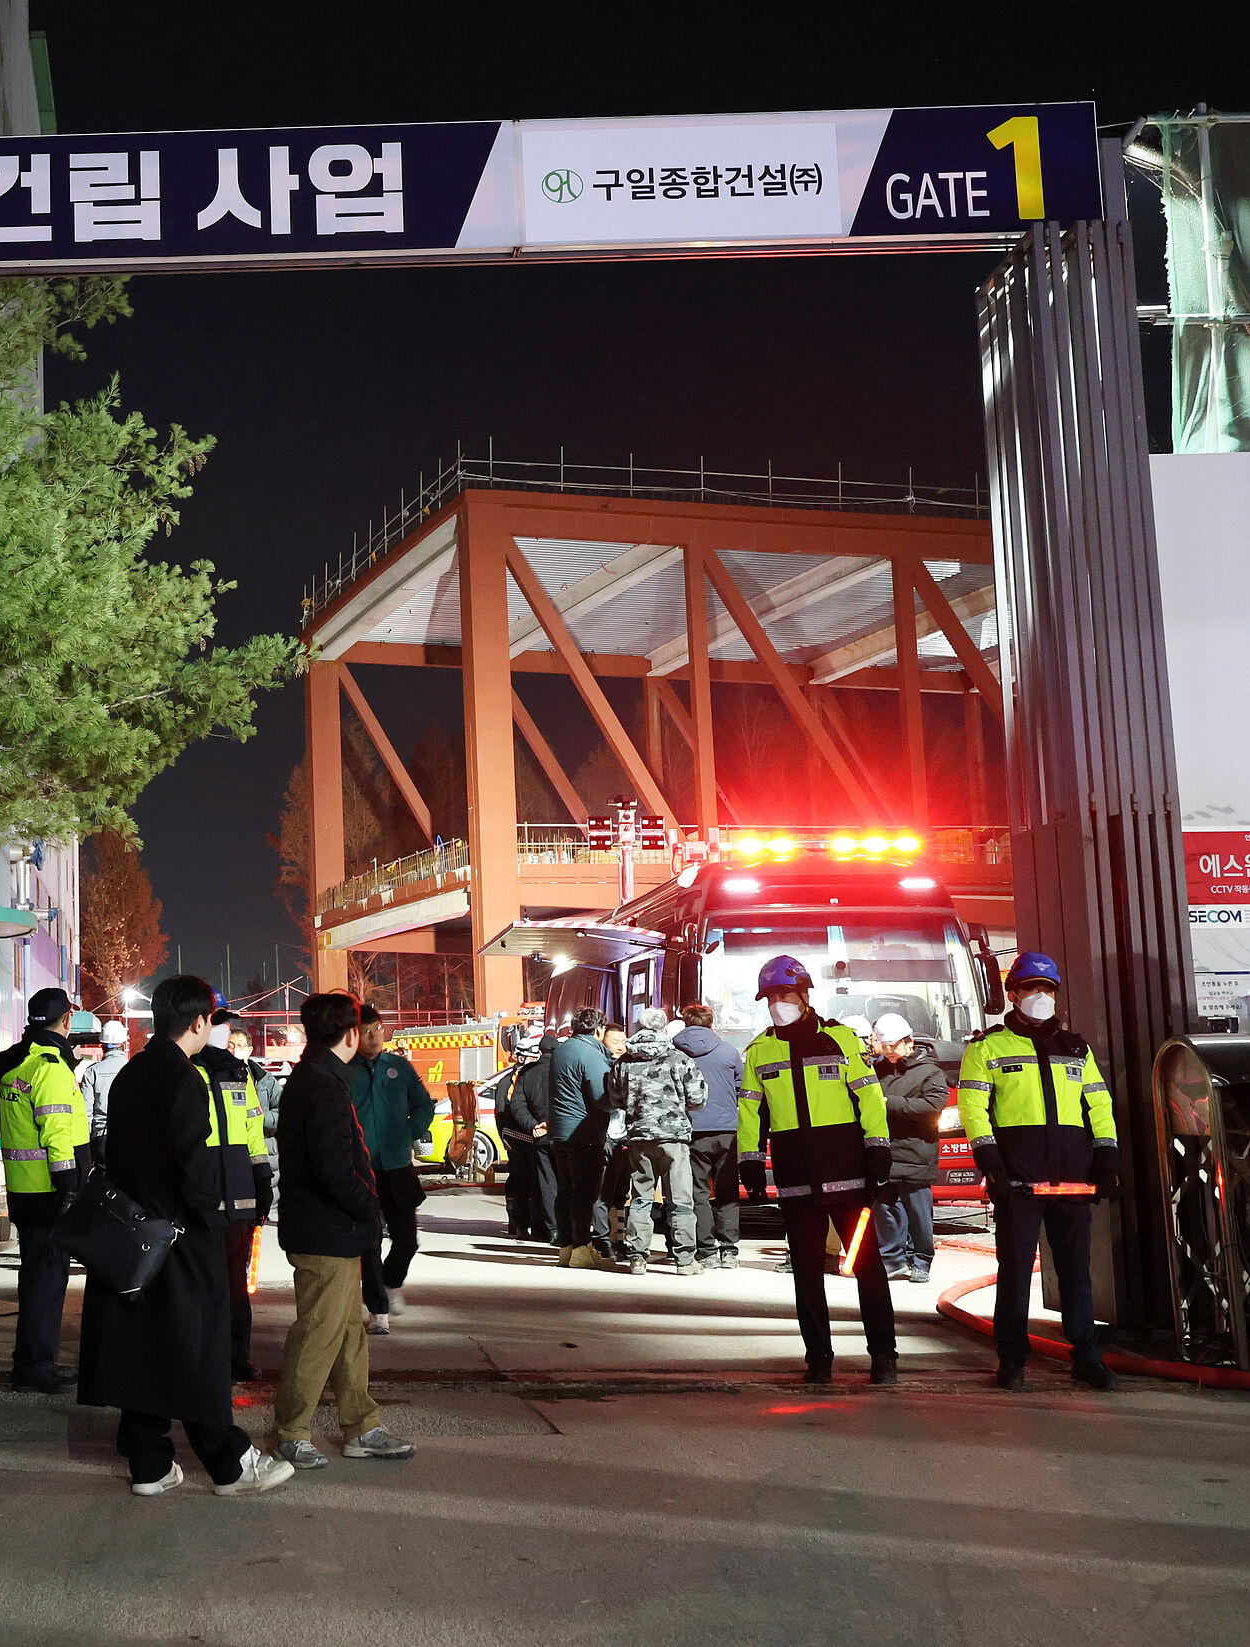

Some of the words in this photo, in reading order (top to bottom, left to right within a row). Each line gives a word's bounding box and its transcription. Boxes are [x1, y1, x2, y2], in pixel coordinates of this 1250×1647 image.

[197, 141, 405, 235] 사업
[885, 171, 990, 219] GATE
[986, 116, 1045, 220] 1
[1188, 909, 1242, 923] SECOM
[1210, 885, 1233, 894] CCTV
[1234, 885, 1250, 894] 작동
